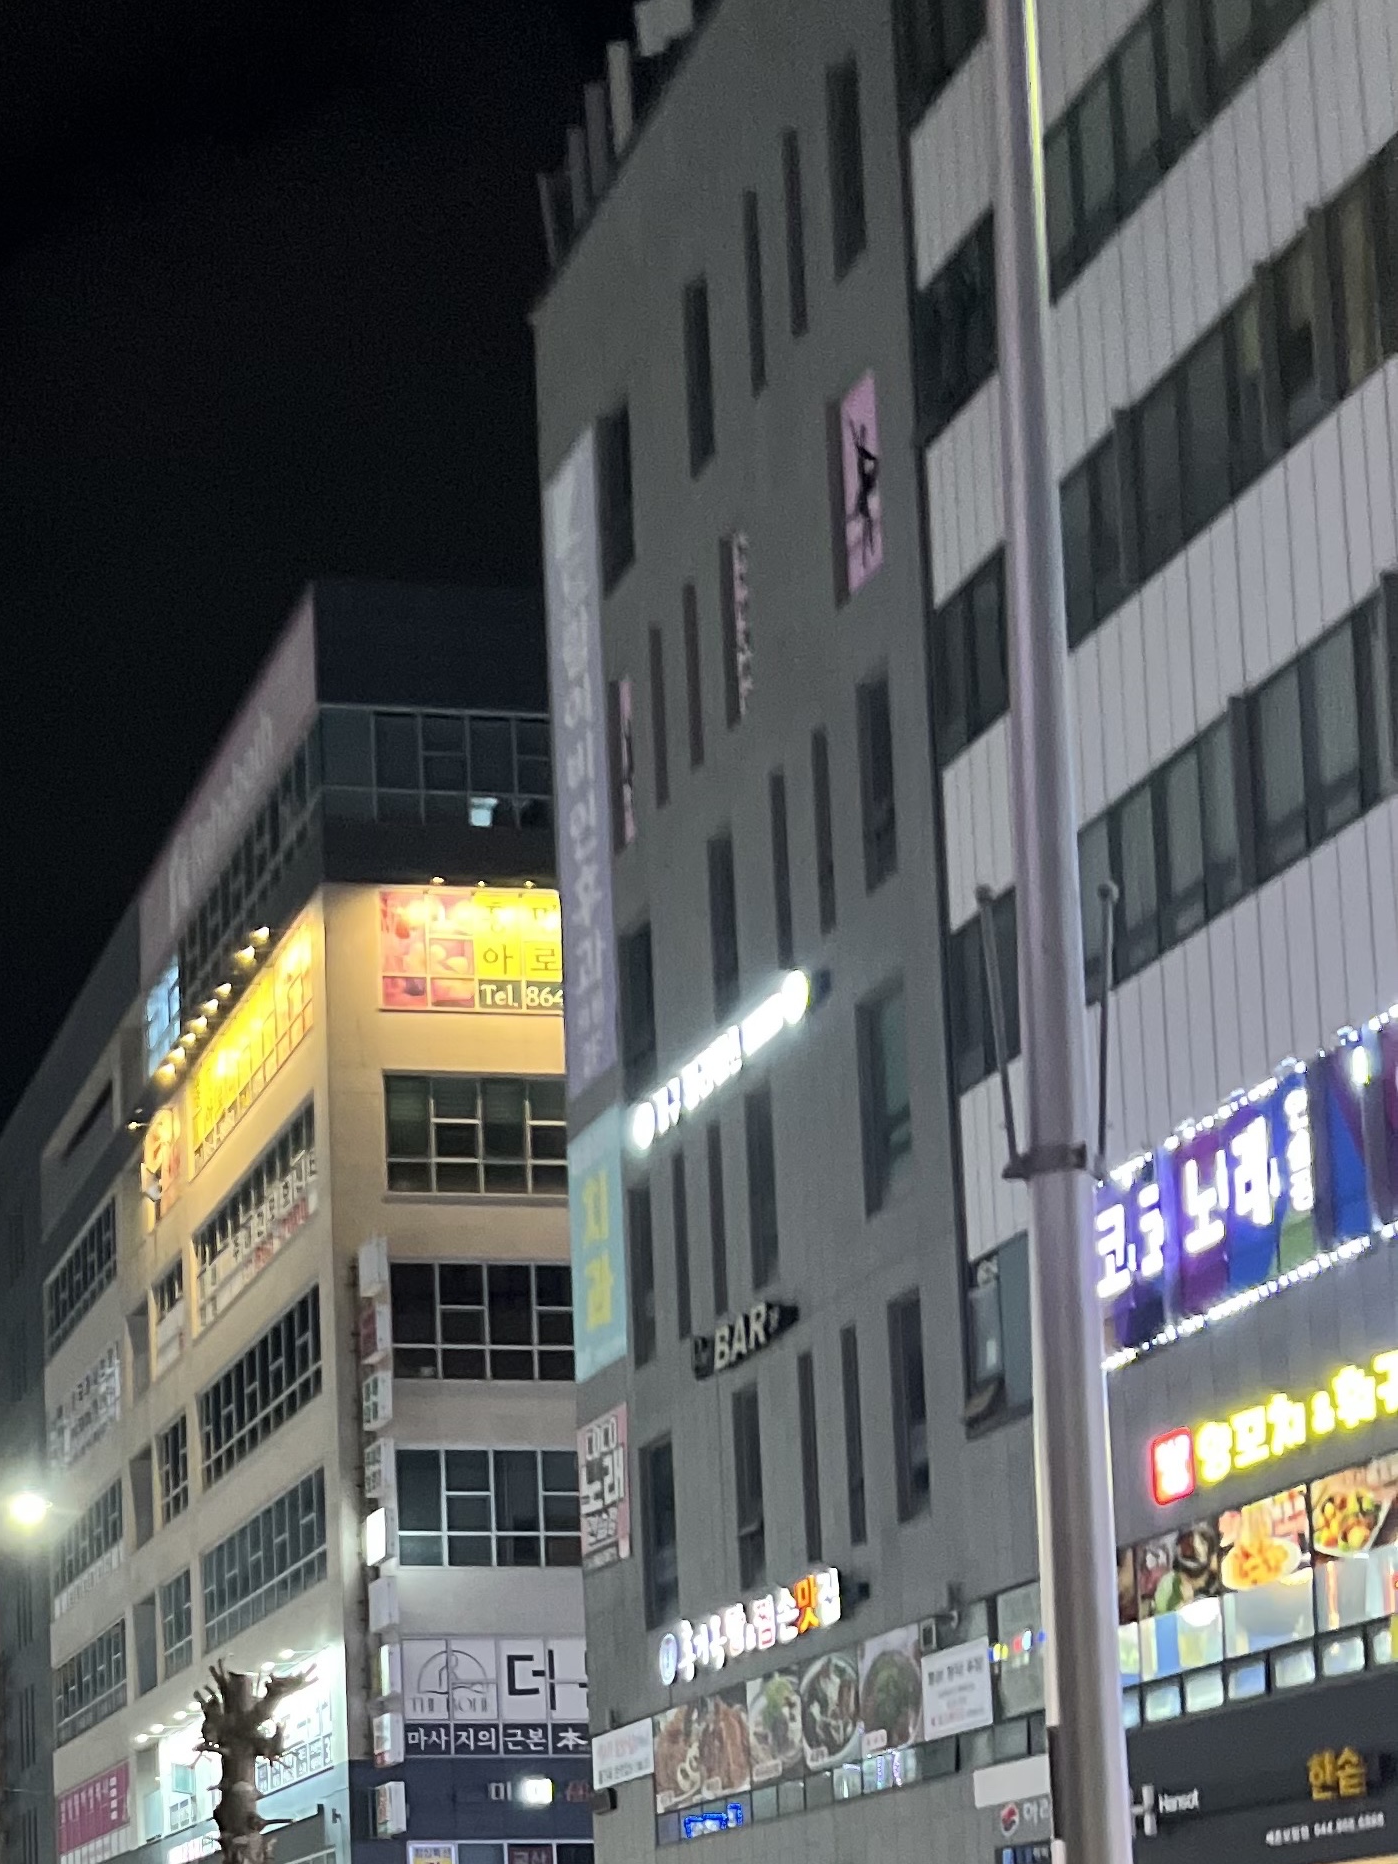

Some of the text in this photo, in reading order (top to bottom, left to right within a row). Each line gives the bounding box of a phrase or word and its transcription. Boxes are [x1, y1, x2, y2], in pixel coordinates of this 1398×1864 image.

[479, 984, 519, 1008] Tel.
[1184, 1114, 1281, 1254] 노래
[714, 1302, 768, 1370] BAR
[579, 1444, 625, 1515] 노래
[507, 1649, 588, 1711] 더
[407, 1727, 589, 1752] 마사지의 근본 本
[1308, 1746, 1367, 1801] 한솥
